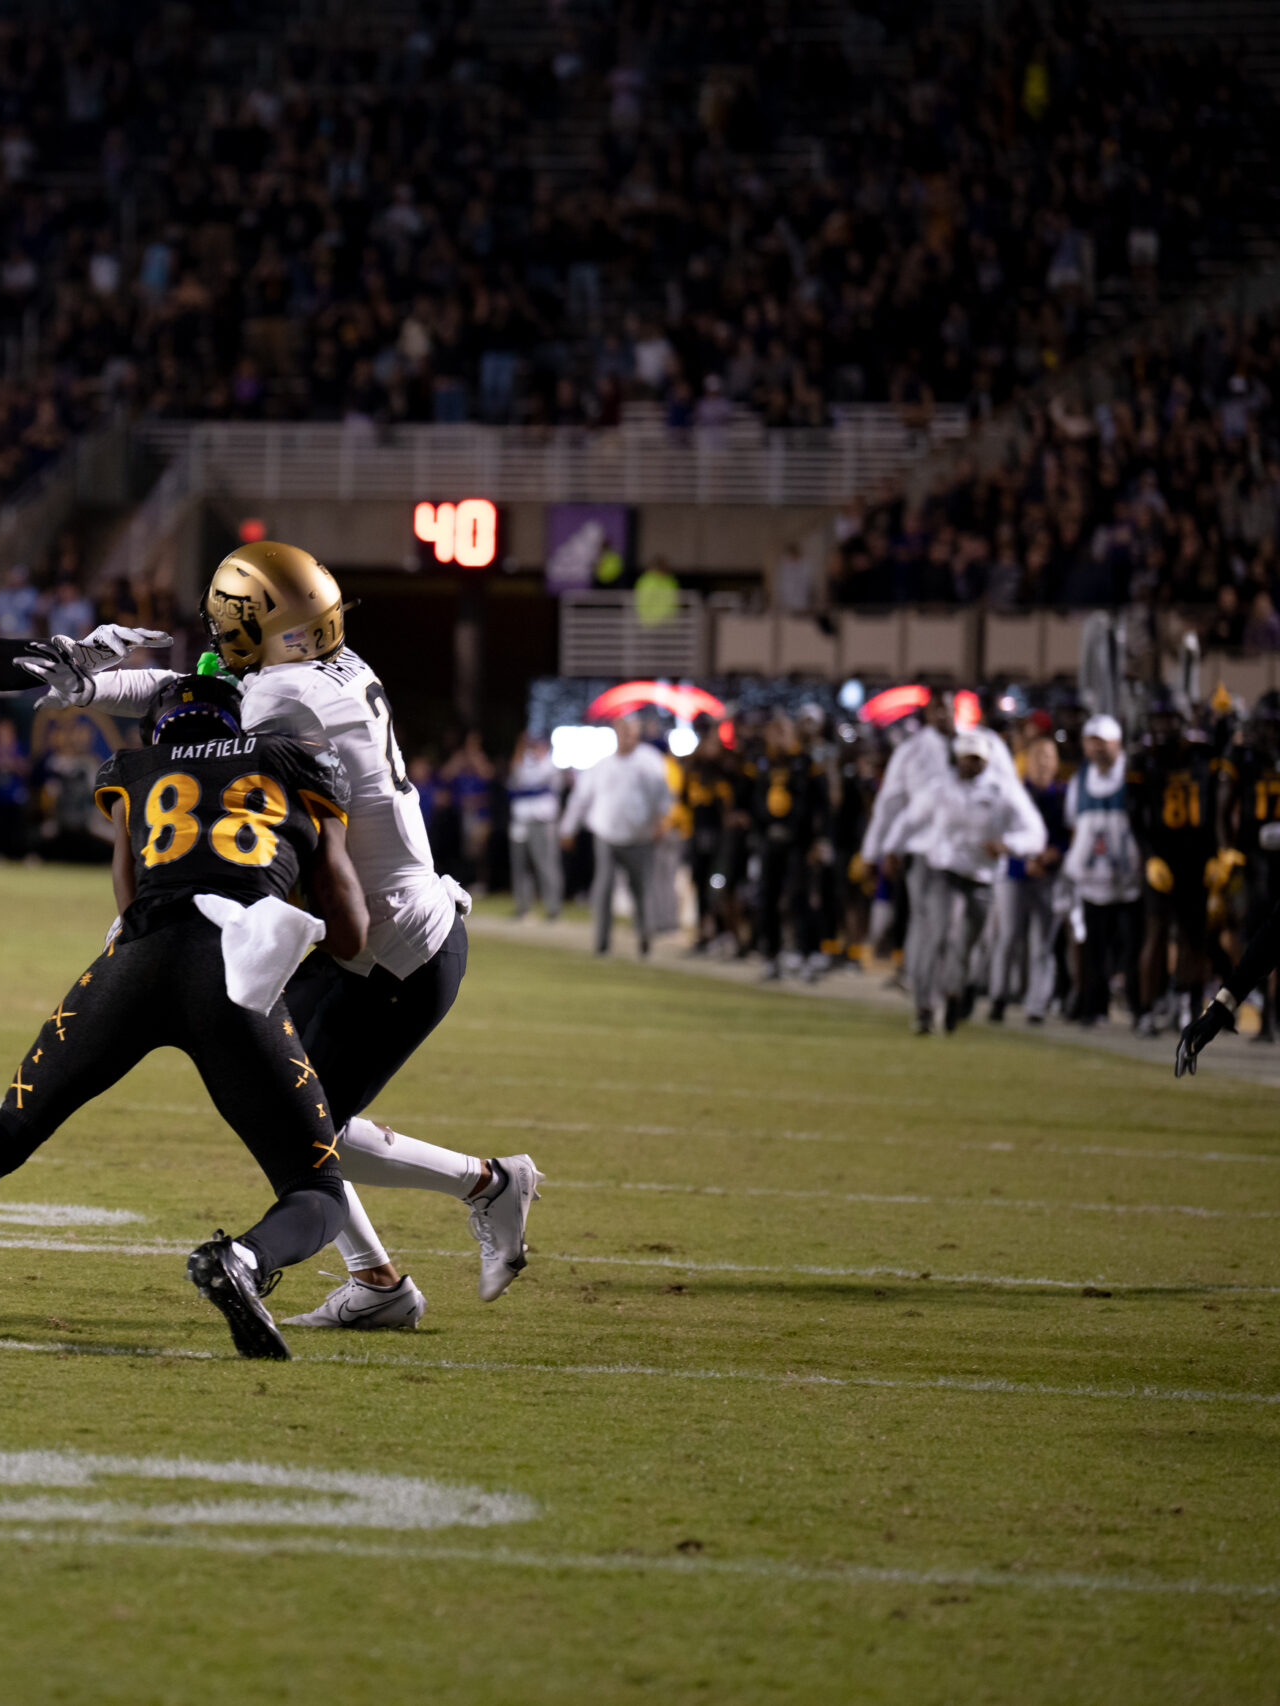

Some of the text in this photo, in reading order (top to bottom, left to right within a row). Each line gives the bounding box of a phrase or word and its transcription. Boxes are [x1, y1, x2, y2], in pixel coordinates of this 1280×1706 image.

[414, 499, 496, 567] 40
[313, 619, 336, 650] 21
[171, 734, 257, 760] HATFIELD
[140, 771, 289, 869] 88
[1161, 779, 1201, 830] 81
